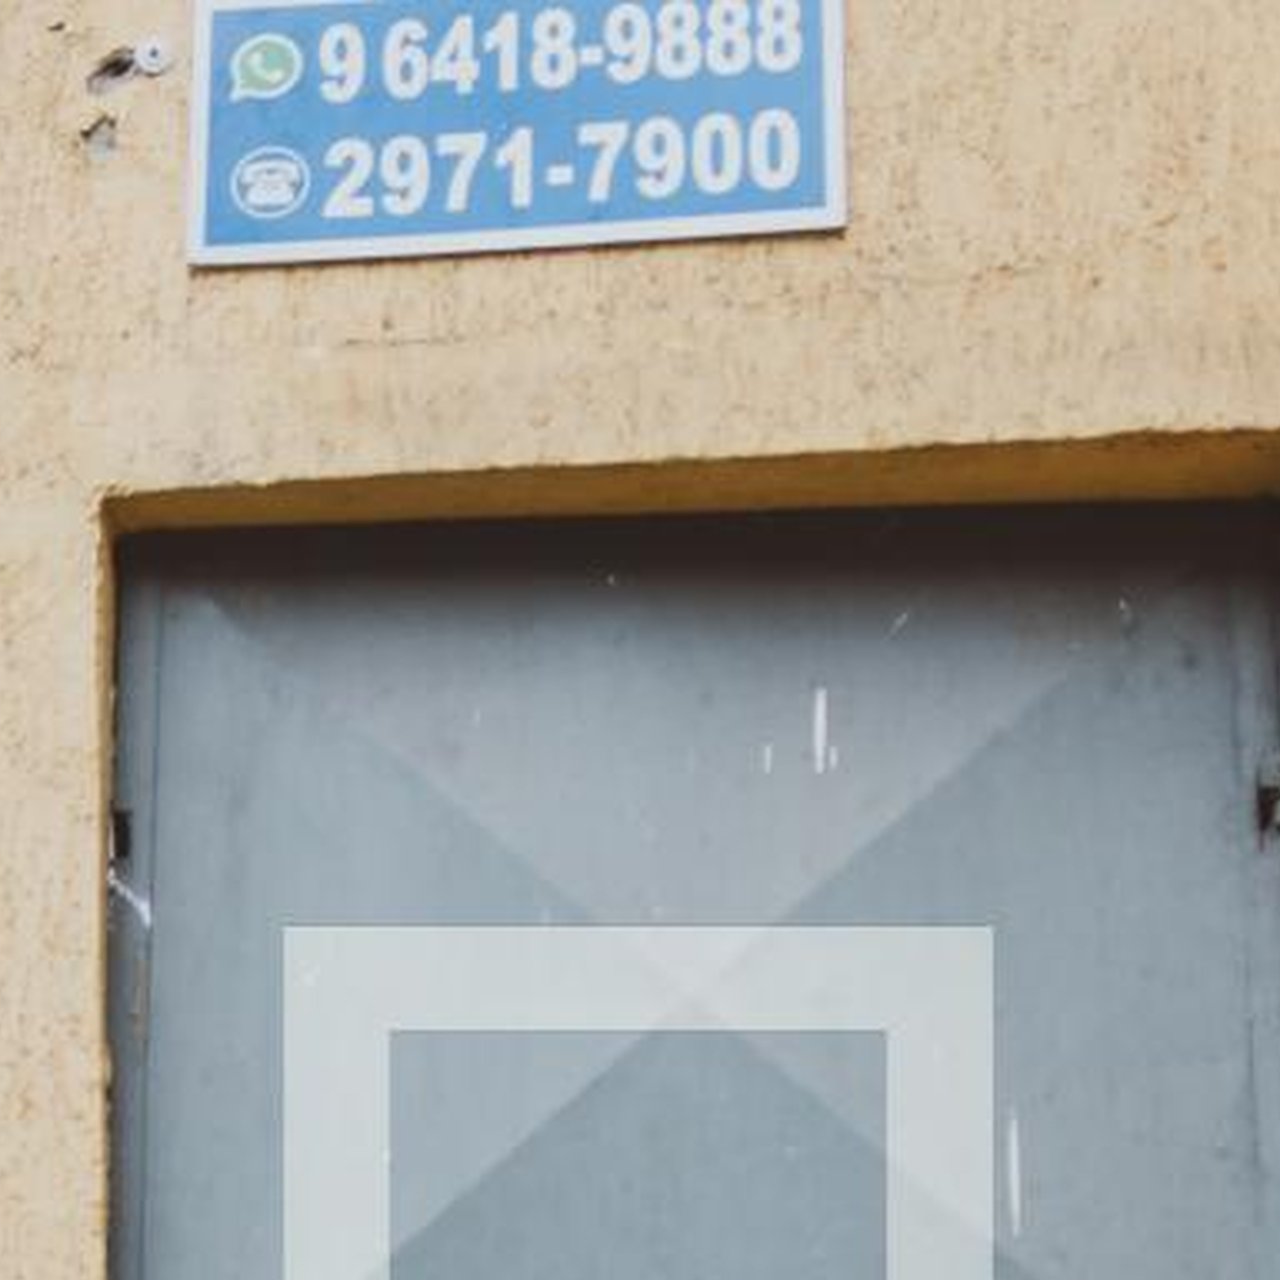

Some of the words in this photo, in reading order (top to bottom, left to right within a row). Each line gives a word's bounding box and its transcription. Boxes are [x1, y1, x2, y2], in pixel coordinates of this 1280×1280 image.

[318, 22, 366, 104] 9
[380, 0, 804, 101] 6418-9888
[320, 108, 801, 218] 2971-7900
